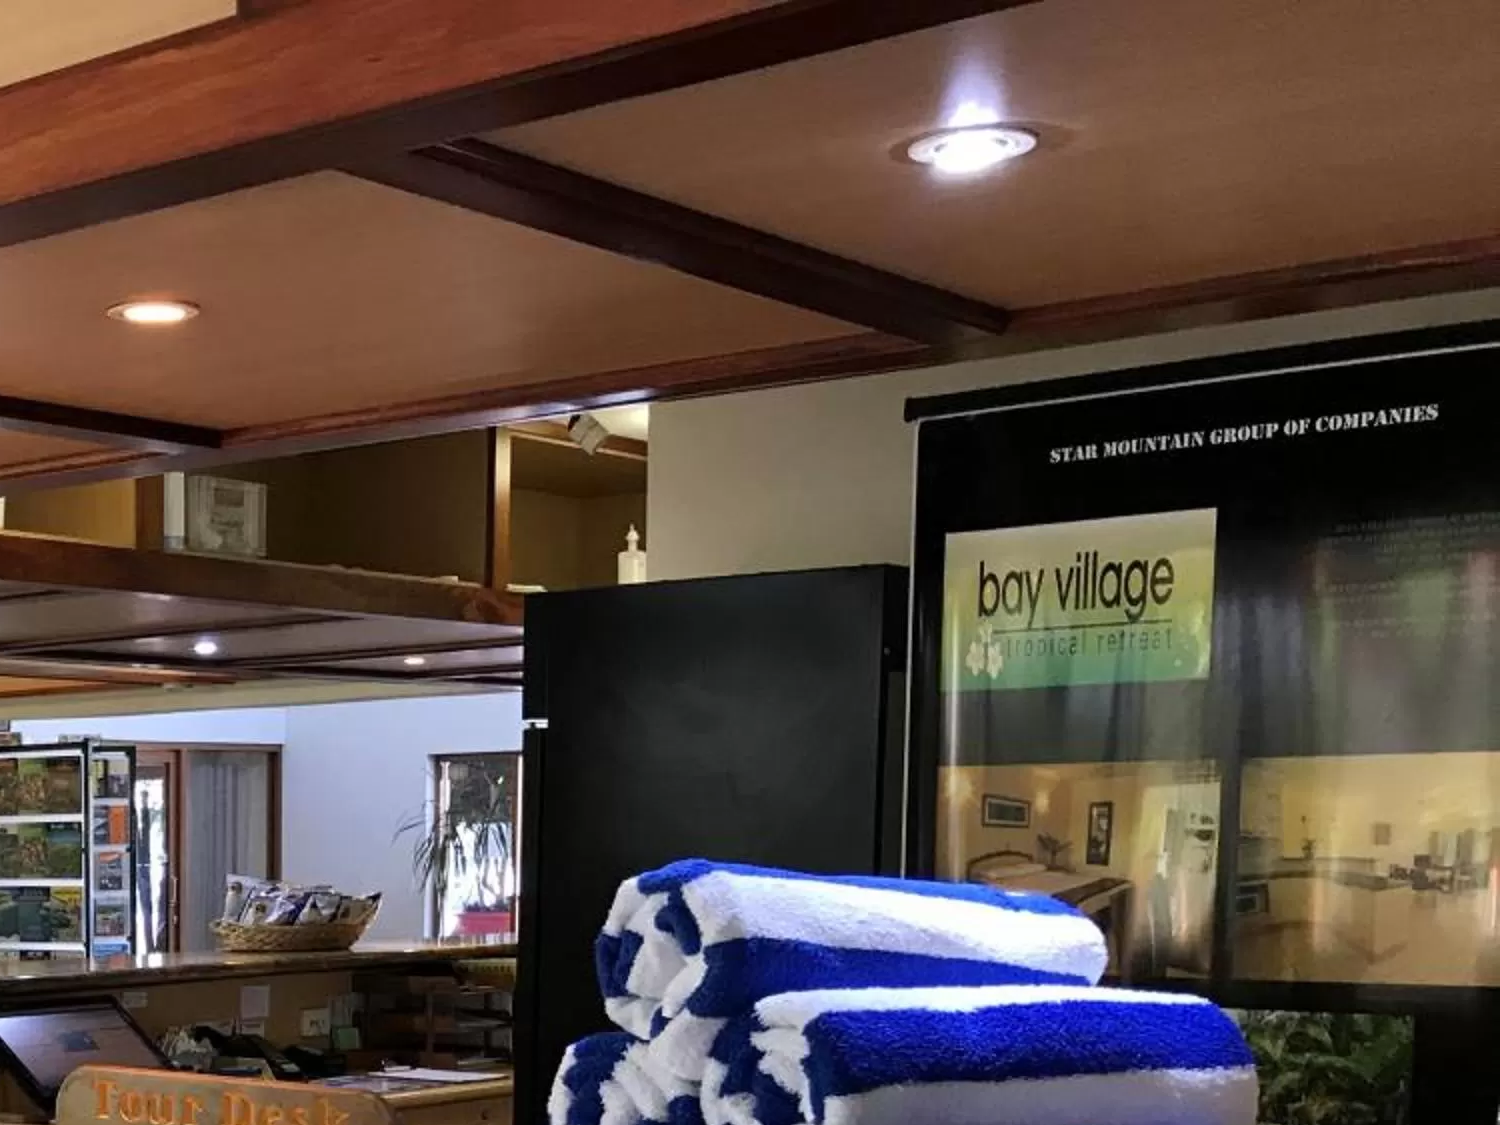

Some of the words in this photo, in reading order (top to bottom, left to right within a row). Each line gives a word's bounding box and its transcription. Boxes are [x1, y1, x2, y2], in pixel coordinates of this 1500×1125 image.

[1049, 443, 1098, 464] STAR
[1102, 431, 1205, 459] MOUNTAIN
[1209, 422, 1279, 446] GROUP
[1283, 418, 1311, 437] OF
[1315, 403, 1440, 433] COMPANIES
[978, 560, 1044, 629] bay
[1055, 550, 1174, 624] village
[1006, 629, 1086, 659] tropical
[1096, 627, 1172, 655] retreat
